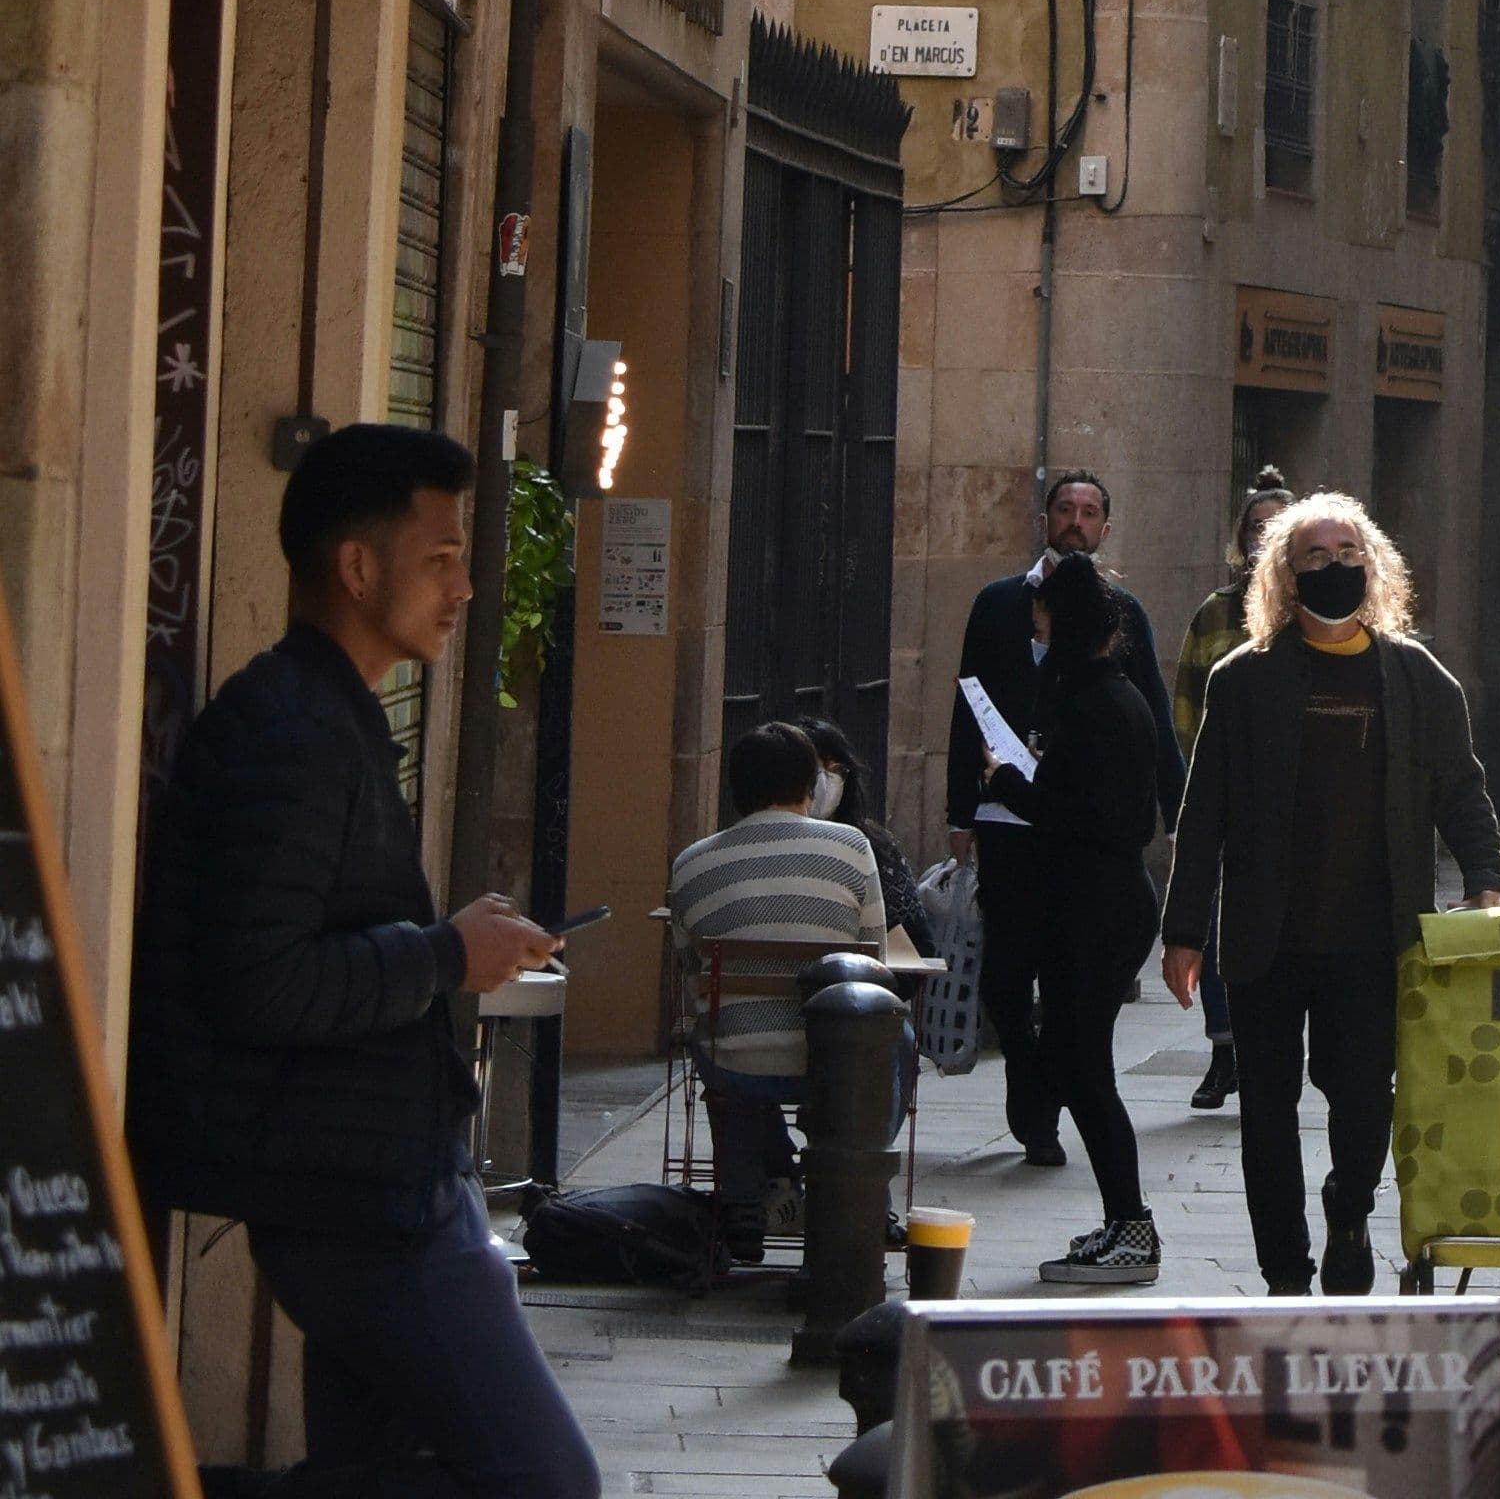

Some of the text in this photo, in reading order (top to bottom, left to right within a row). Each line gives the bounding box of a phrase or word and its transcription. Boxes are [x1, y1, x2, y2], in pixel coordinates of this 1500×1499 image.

[897, 18, 950, 32] PLACETA
[914, 40, 965, 64] MARCÚS
[979, 1351, 1473, 1401] CAFÉ PARA LLEVAR
